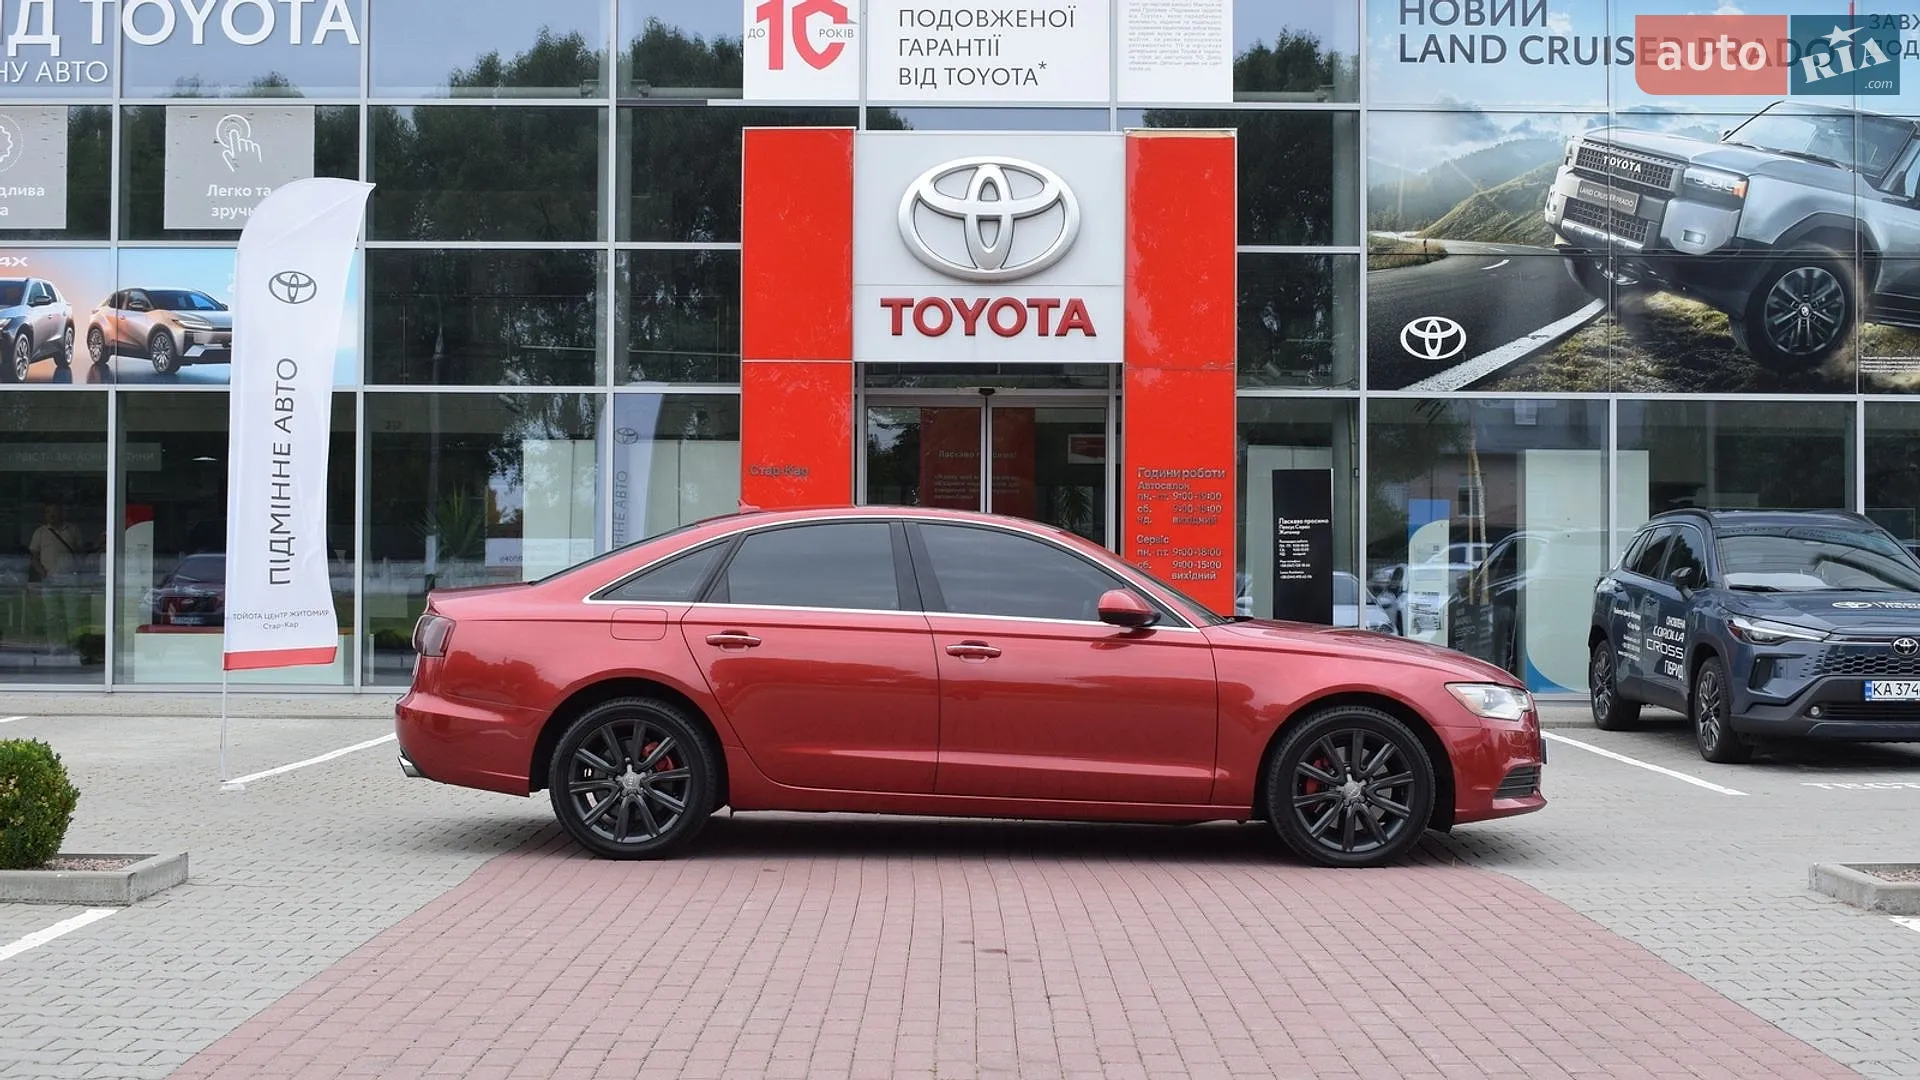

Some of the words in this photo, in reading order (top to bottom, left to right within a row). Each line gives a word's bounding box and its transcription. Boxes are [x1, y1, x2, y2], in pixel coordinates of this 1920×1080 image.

[79, 0, 360, 45] TOYOTA
[899, 5, 1076, 30] ПОДОВЖЕНОЇ
[748, 28, 766, 39] ДО
[819, 28, 855, 38] РОКІВ
[899, 34, 1001, 56] ГАРАНТІЇ
[1400, 34, 1507, 63] LAND
[1519, 35, 1684, 67] CRUISER
[35, 61, 108, 82] АВТО
[899, 67, 937, 88] ВІД
[1603, 156, 1642, 173] TOYOTA
[207, 184, 252, 197] Легко
[255, 187, 272, 197] та
[880, 297, 1097, 337] TOYOTA
[273, 358, 298, 434] АВТО
[269, 442, 296, 585] ПІДМІННЕ
[232, 611, 263, 621] ТОЙОТА
[290, 608, 329, 619] ЖИТОМИР
[1653, 625, 1685, 643] COROLLA
[1646, 638, 1684, 660] CROSS
[1873, 682, 1893, 696] KA
[1895, 682, 1919, 696] 374
